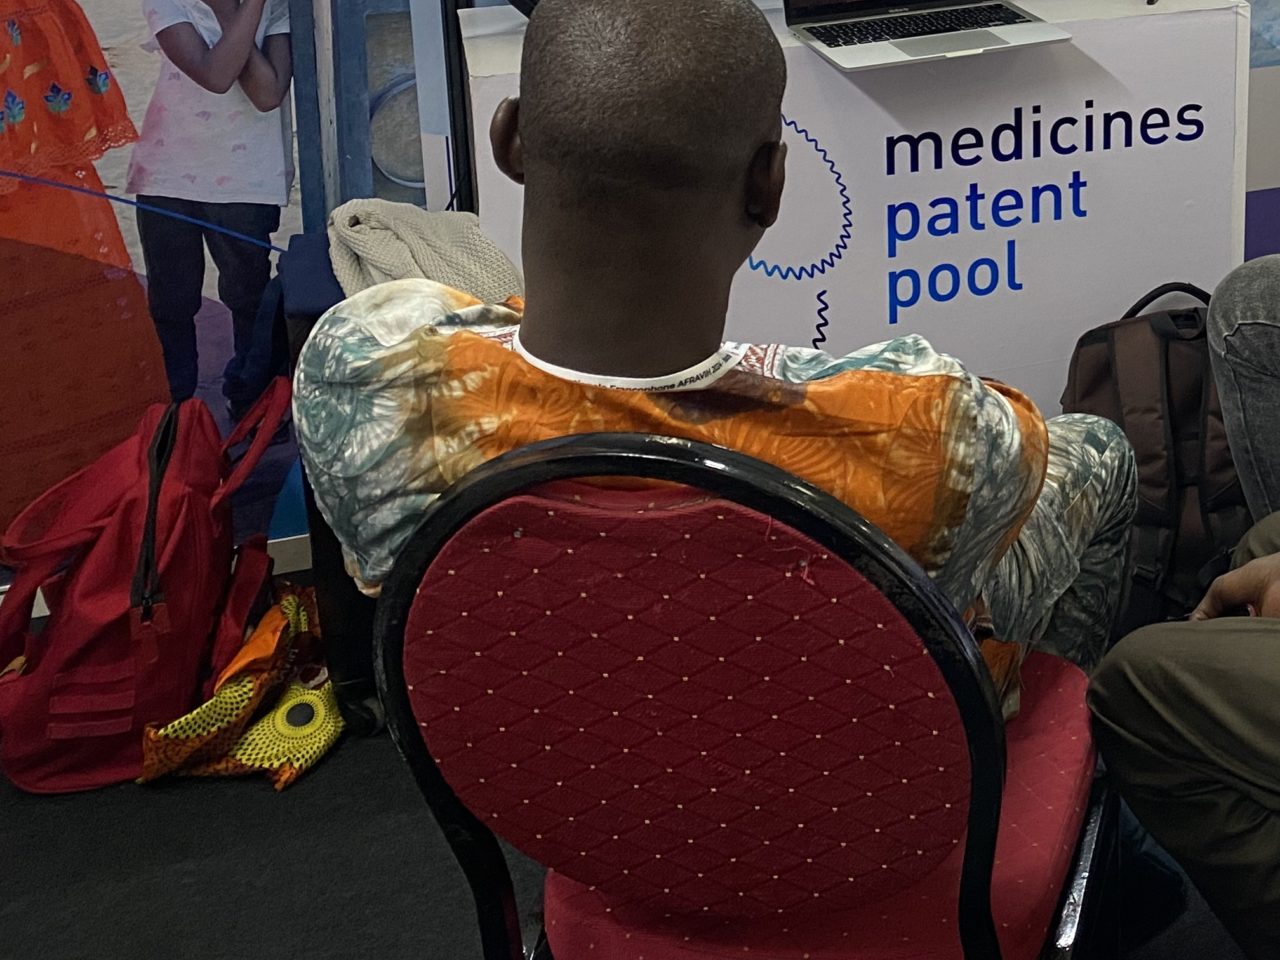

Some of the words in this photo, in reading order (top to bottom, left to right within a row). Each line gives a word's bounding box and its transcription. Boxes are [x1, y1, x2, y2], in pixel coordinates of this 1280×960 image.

[885, 99, 1205, 176] medicines
[887, 171, 1088, 258] patent
[888, 240, 1023, 325] pool
